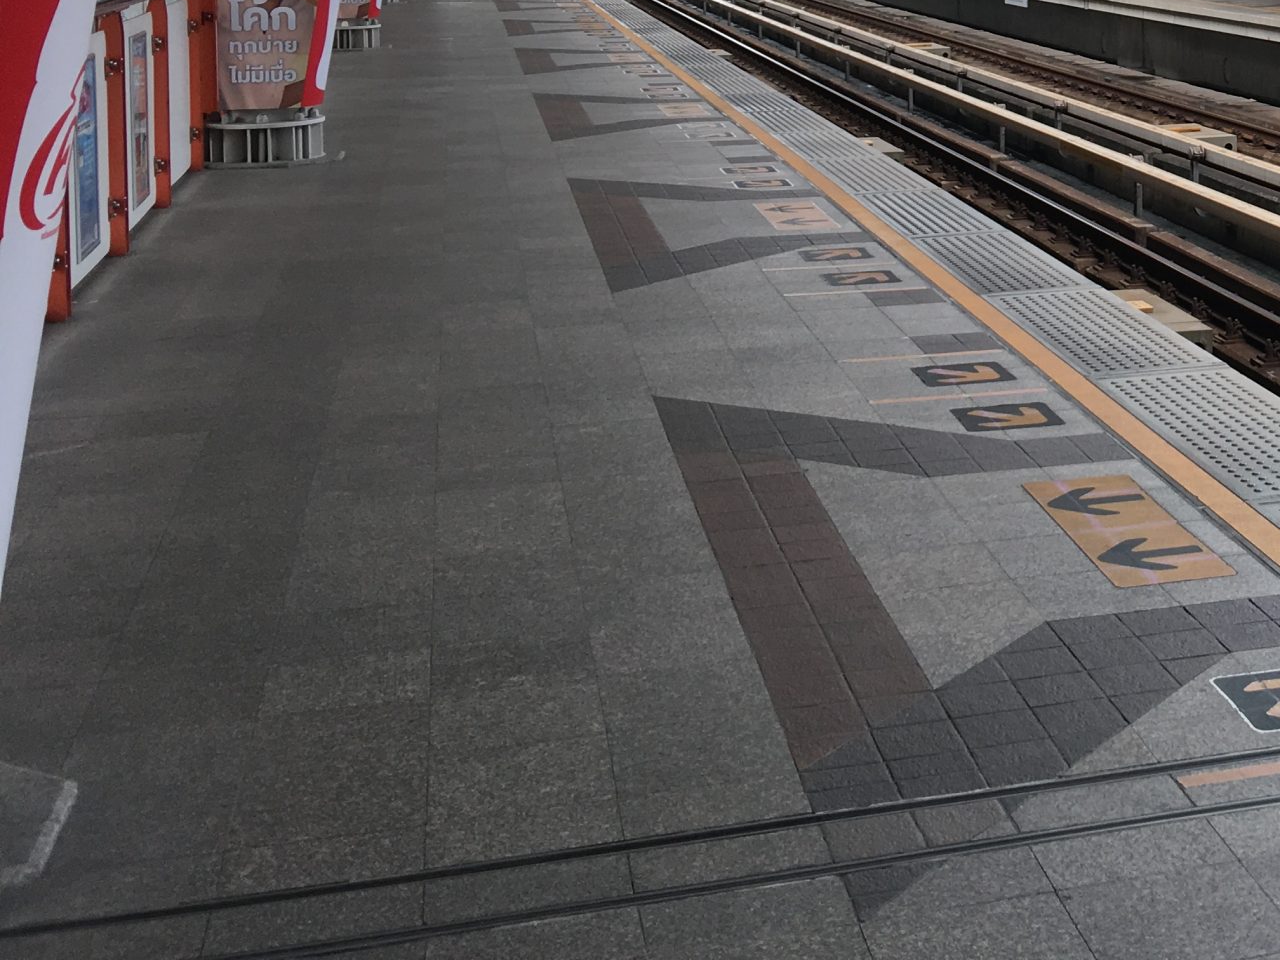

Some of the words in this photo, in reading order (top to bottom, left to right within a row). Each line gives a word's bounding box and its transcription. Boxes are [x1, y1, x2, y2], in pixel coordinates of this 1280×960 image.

[229, 35, 298, 61] ทุกบ่าย
[228, 59, 298, 84] ไม่มีเบื่อ
